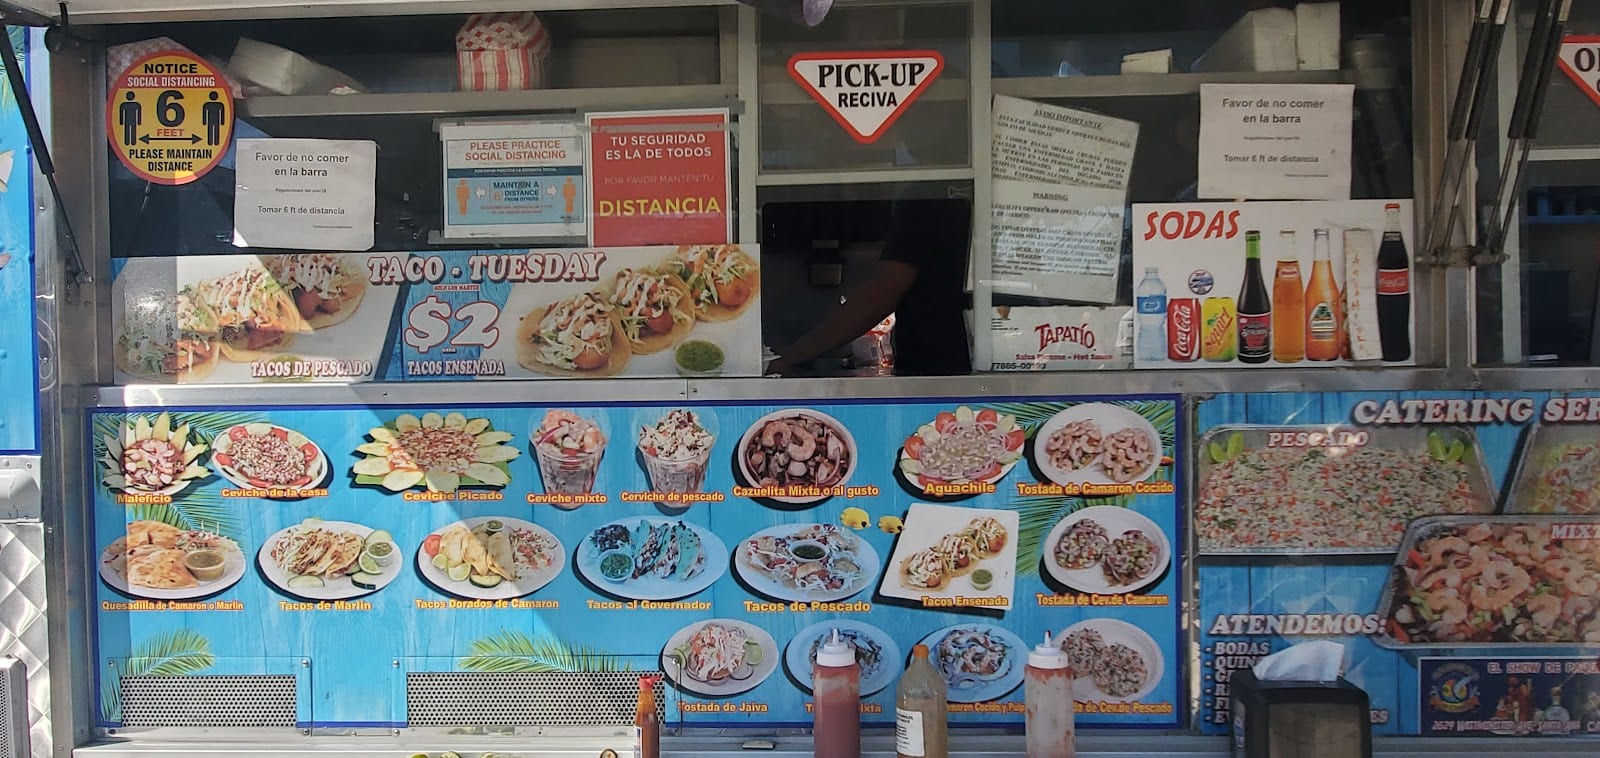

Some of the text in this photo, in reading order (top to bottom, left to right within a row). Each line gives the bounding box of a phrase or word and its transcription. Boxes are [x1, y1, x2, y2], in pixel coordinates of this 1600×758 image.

[144, 64, 198, 74] NOTICE
[818, 63, 925, 88] PICK-UP
[127, 76, 215, 88] SOCIAL DISTANCING
[838, 92, 898, 108] RECIVA
[1222, 98, 1324, 109] Favor de no comer
[156, 90, 185, 128] 6
[1243, 113, 1301, 124] en la barra
[156, 128, 184, 137] FEET
[470, 140, 561, 150] PLEASE PRACTICE
[610, 133, 706, 146] TU SEGURIDAD
[129, 149, 212, 160] PLEASE MAINTAIN
[255, 152, 350, 163] Favor de no comer
[465, 150, 566, 161] SOCIAL DISTANCING
[605, 146, 712, 160] ES LA DE TODOS
[1224, 155, 1250, 163] Tomar
[1280, 155, 1319, 163] distancia
[148, 162, 193, 172] DISTANCE
[274, 167, 328, 177] en la barra
[493, 181, 532, 189] MAINTN
[604, 177, 624, 185] POR
[626, 176, 657, 185] FAVOR
[702, 174, 714, 183] TU
[1033, 192, 1069, 202] WARNING
[258, 206, 345, 215] Tomar 6 ft de distancia
[599, 196, 721, 218] DISTANCIA
[1144, 210, 1241, 241] SODAS
[367, 256, 445, 284] TACO
[468, 252, 606, 283] TUESDAY
[404, 295, 501, 354] $2
[1034, 322, 1095, 352] TAPATÍO
[250, 361, 373, 376] TACOS DE PESCADO
[407, 360, 506, 376] TACOS ENSENADA
[1352, 397, 1600, 425] CATERING SER
[1267, 431, 1370, 448] PESCADO
[221, 488, 329, 498] Ceviche de la casa
[733, 486, 880, 498] Cazuelita Mixta o al gusto
[924, 483, 996, 495] Aguachile
[1018, 482, 1175, 495] Tostada de Camaron Cocido
[117, 494, 171, 504] Maleficio
[403, 491, 504, 501] Ceviche Picado
[526, 494, 608, 503] Ceviche mixto
[620, 492, 725, 504] Cerviche de pescado
[279, 600, 372, 611] Tacos de Marlin
[415, 599, 559, 609] Tacos Dorados de Camaron
[586, 600, 623, 610] Tacos
[640, 600, 711, 610] Governador
[921, 596, 1008, 607] Tacos Ensenada
[1036, 594, 1169, 606] Tostada de Cev.de Camaron
[102, 601, 155, 612] Quesadilla
[156, 602, 167, 610] de
[169, 602, 207, 610] Camaron
[216, 601, 244, 610] Marlin
[744, 600, 872, 612] Tacos de Pescado
[1208, 614, 1388, 636] ATENDEMOS:
[1214, 642, 1270, 655] BODAS
[1487, 662, 1503, 674] EL
[1506, 662, 1542, 674] SHOW
[1544, 662, 1562, 674] DE
[677, 702, 768, 713] Tostada de Jaiva
[858, 703, 882, 713] ixta
[1008, 702, 1026, 713] Pulp
[1086, 702, 1098, 713] de
[1133, 703, 1173, 713] Pescado
